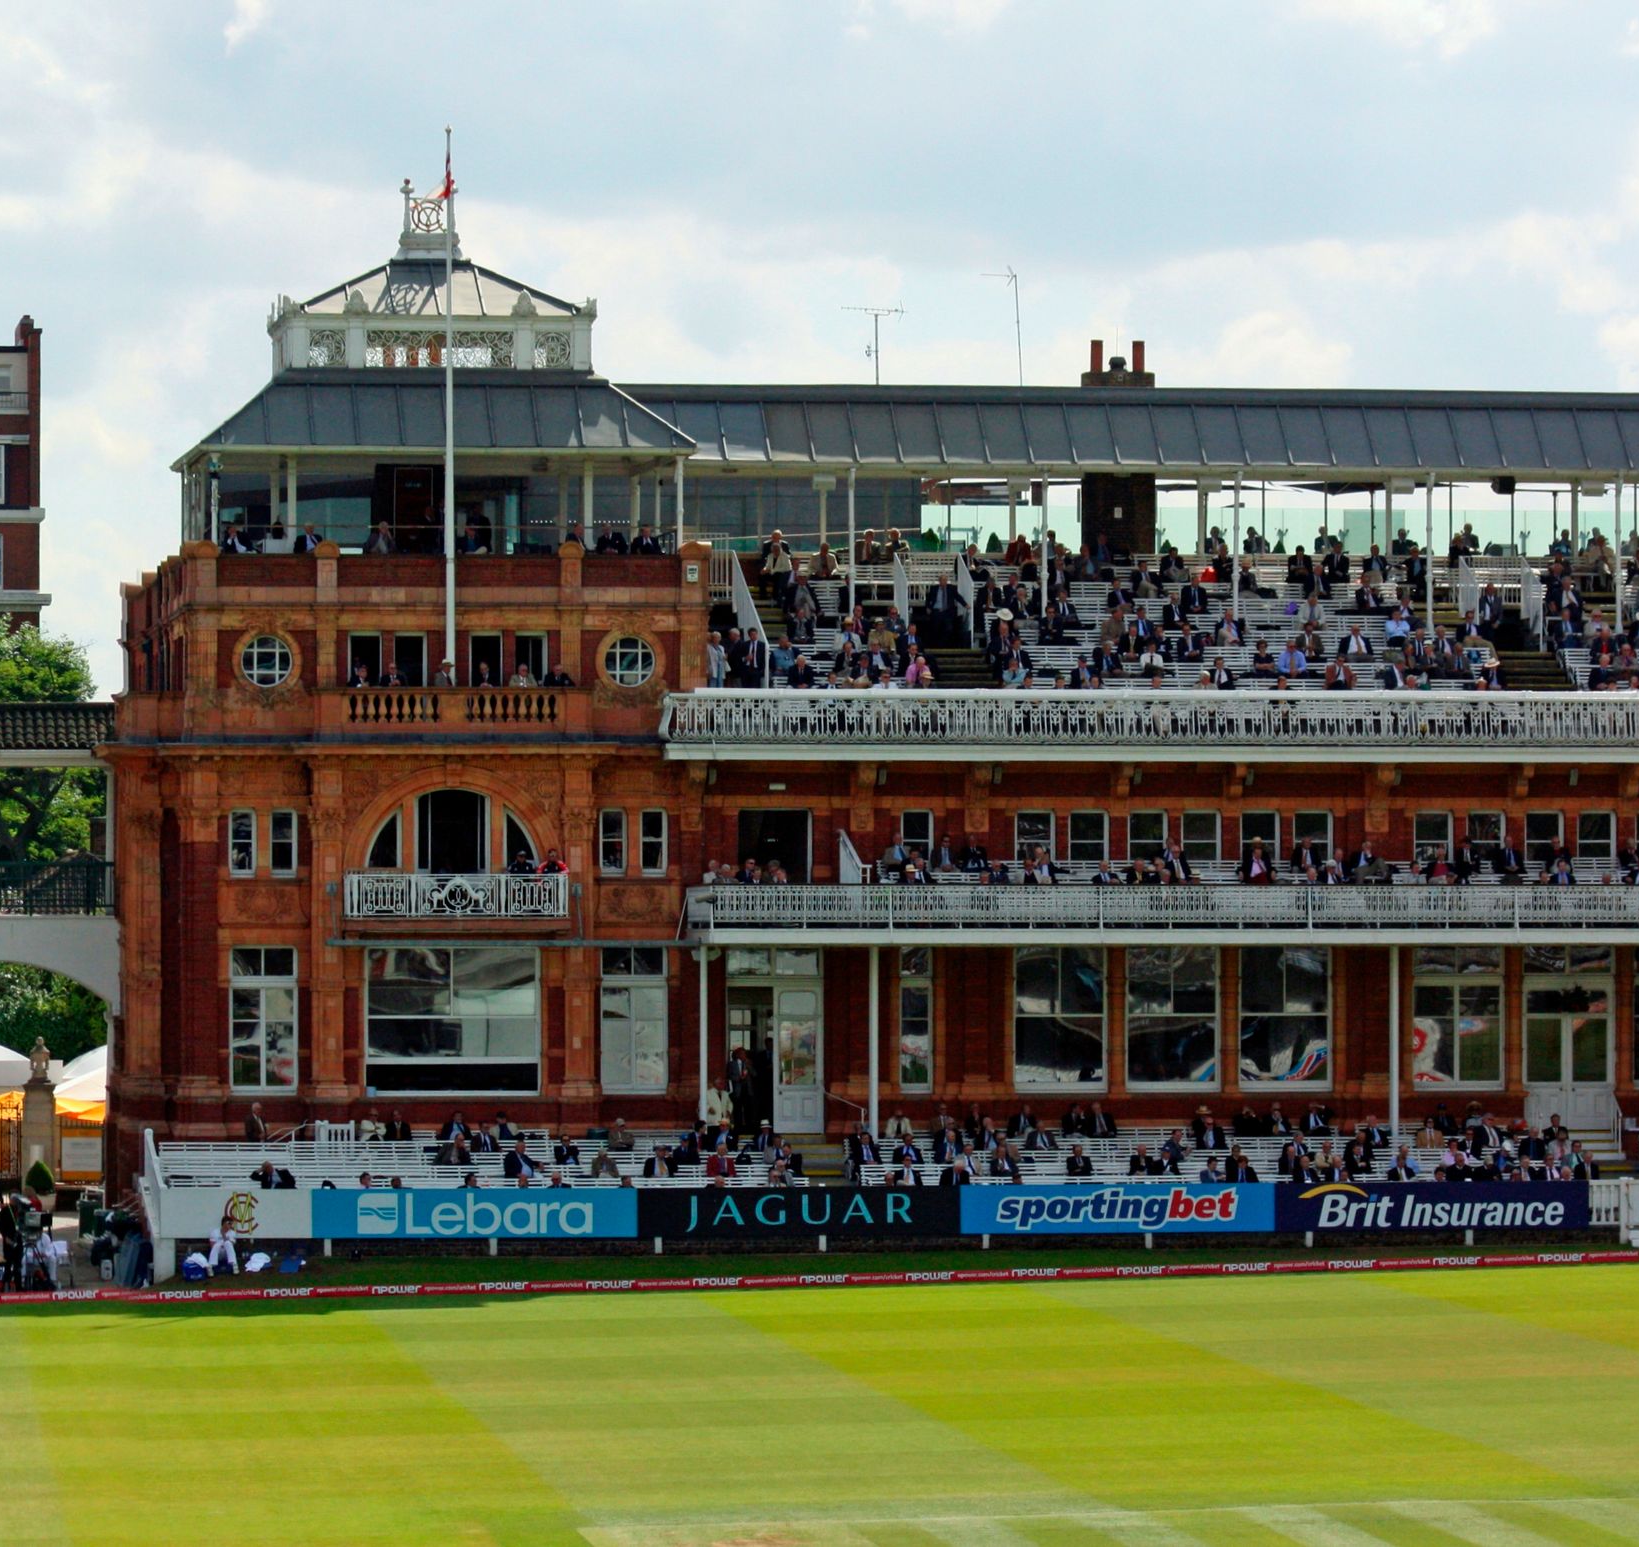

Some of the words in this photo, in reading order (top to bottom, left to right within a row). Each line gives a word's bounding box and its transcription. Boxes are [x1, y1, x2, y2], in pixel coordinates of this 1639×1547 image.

[406, 1193, 593, 1235] Lebara
[687, 1193, 912, 1232] JAGUAR
[996, 1186, 1239, 1230] sportingbet
[1318, 1194, 1394, 1227] Brit
[1401, 1195, 1564, 1226] Insurance
